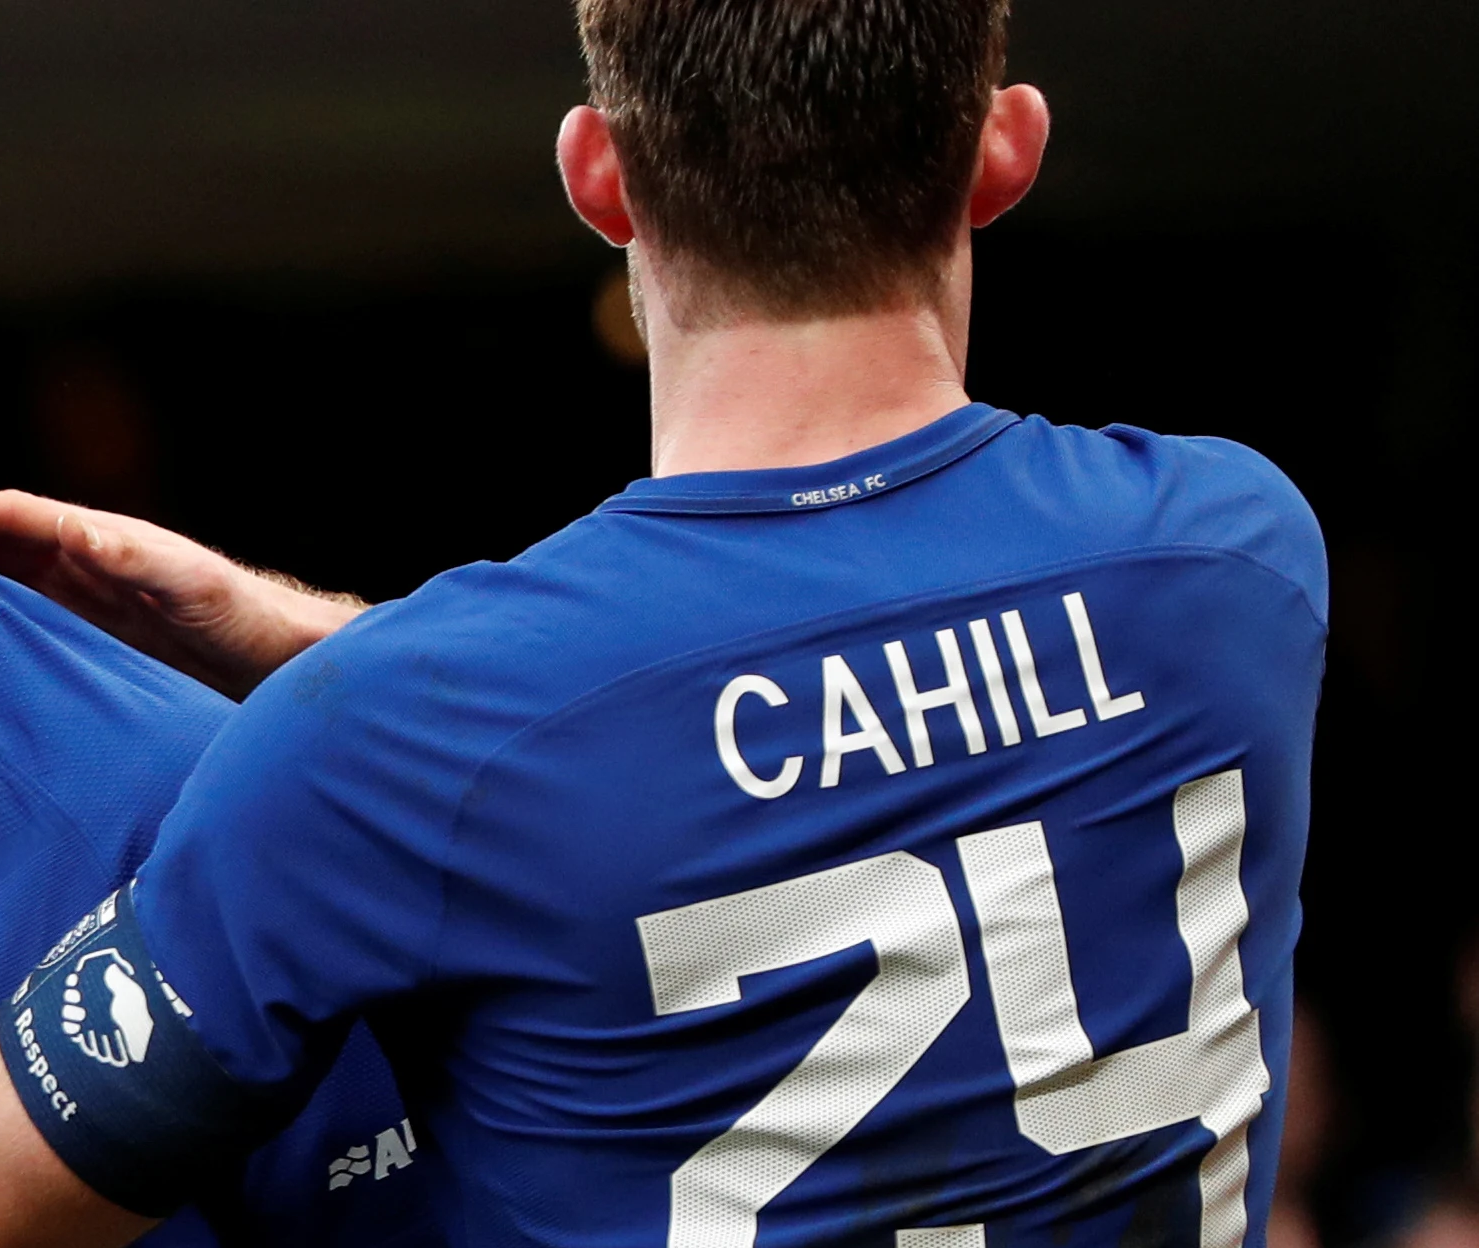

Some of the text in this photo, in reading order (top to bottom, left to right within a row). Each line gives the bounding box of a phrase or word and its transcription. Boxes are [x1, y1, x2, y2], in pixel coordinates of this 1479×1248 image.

[791, 473, 886, 506] CHELSEA FC
[713, 592, 1145, 799] CAHILL
[14, 1007, 78, 1122] Respect
